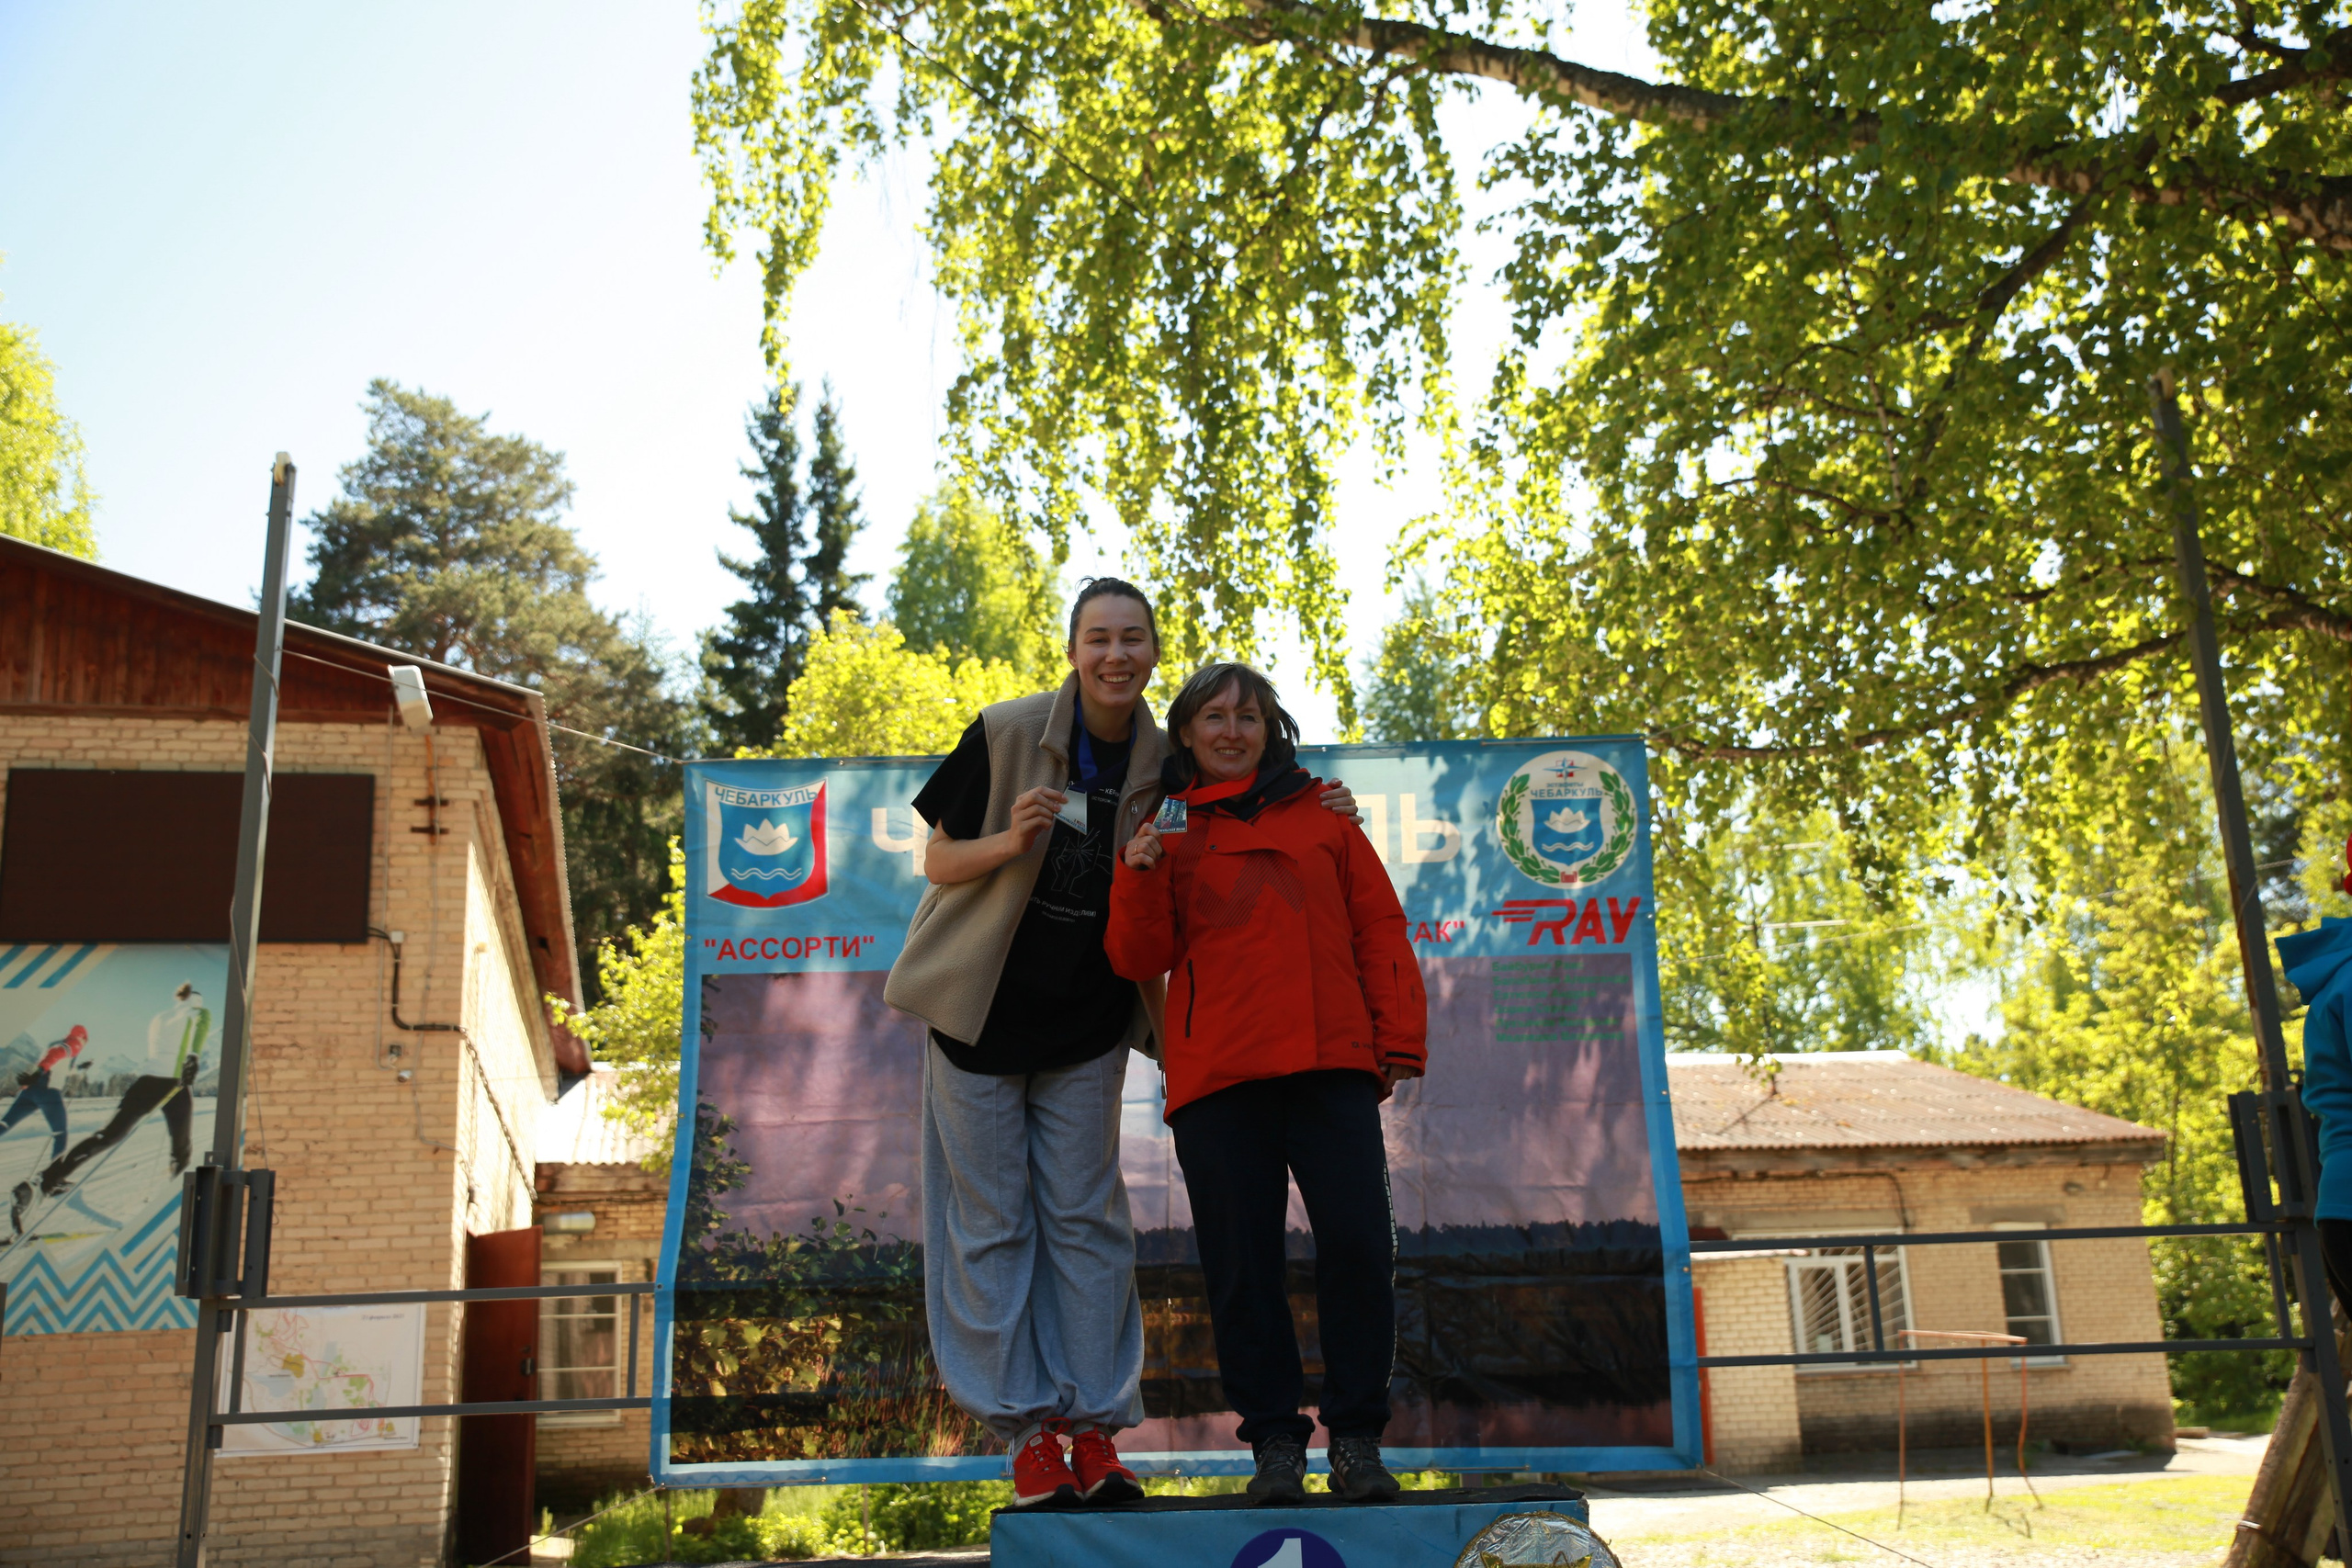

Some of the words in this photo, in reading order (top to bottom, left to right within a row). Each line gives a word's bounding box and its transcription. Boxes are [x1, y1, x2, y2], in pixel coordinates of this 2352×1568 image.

[715, 786, 819, 807] ЧЕБАРКУЛЬ
[1530, 787, 1603, 798] ЧЕБАРКУЛЬ
[704, 935, 876, 961] "АССОРТИ"
